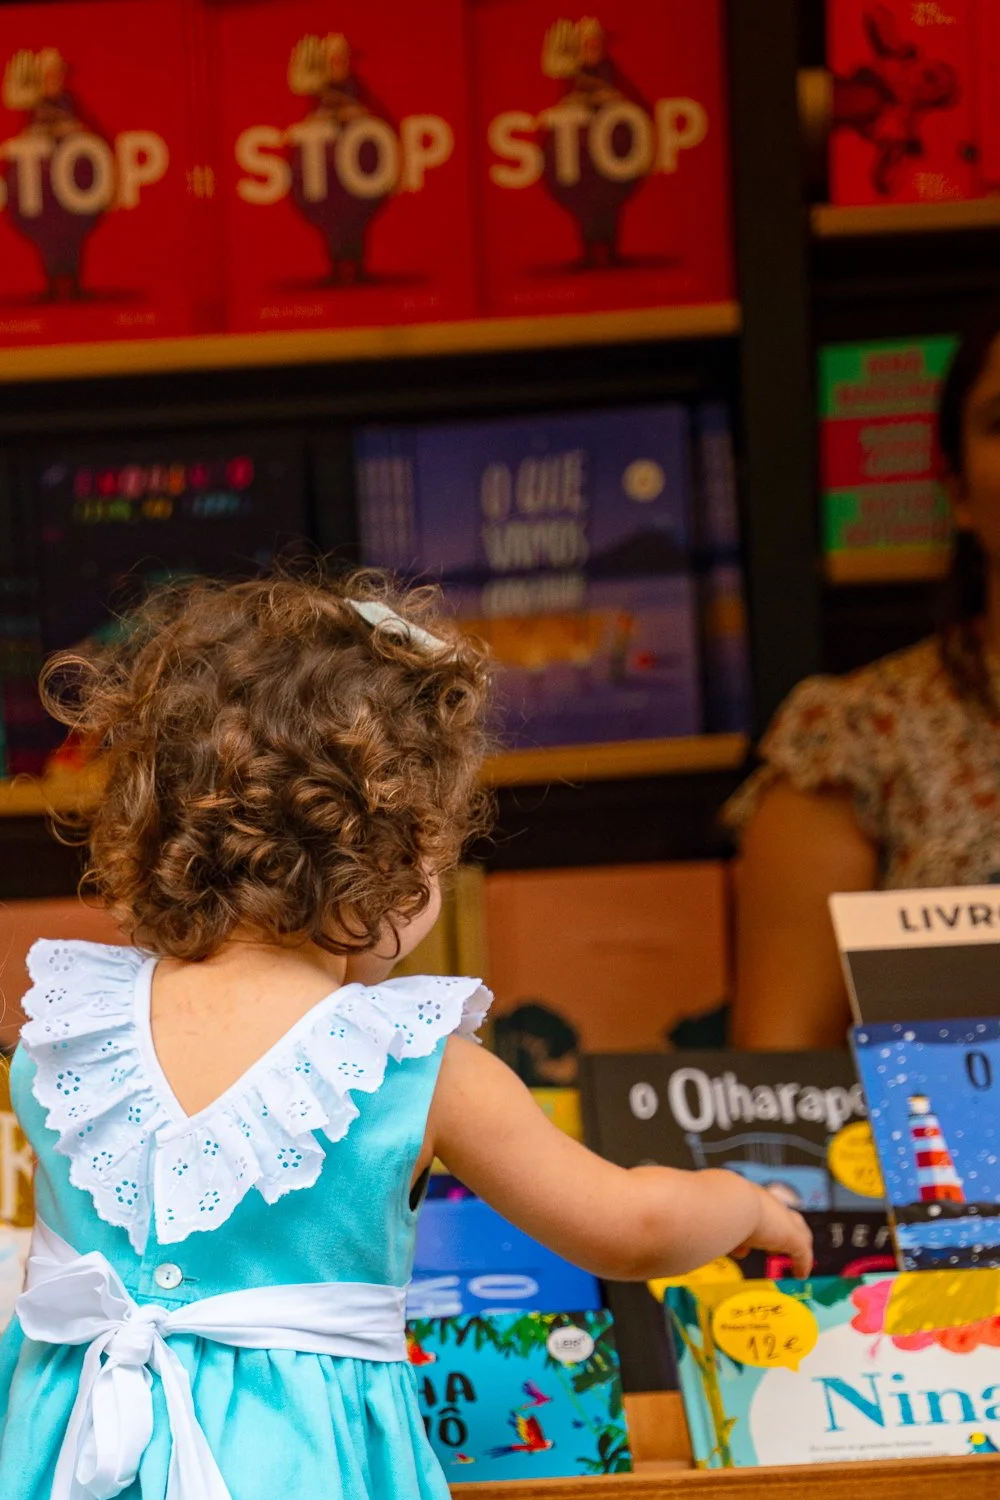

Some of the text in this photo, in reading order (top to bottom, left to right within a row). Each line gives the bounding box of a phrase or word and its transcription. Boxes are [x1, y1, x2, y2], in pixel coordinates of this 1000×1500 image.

[234, 115, 453, 204] STOP
[488, 97, 707, 188] STOP
[899, 903, 1000, 931] LIVR
[965, 1051, 992, 1091] O
[424, 1406, 468, 1447] Ô
[811, 1372, 1000, 1432] Nina
